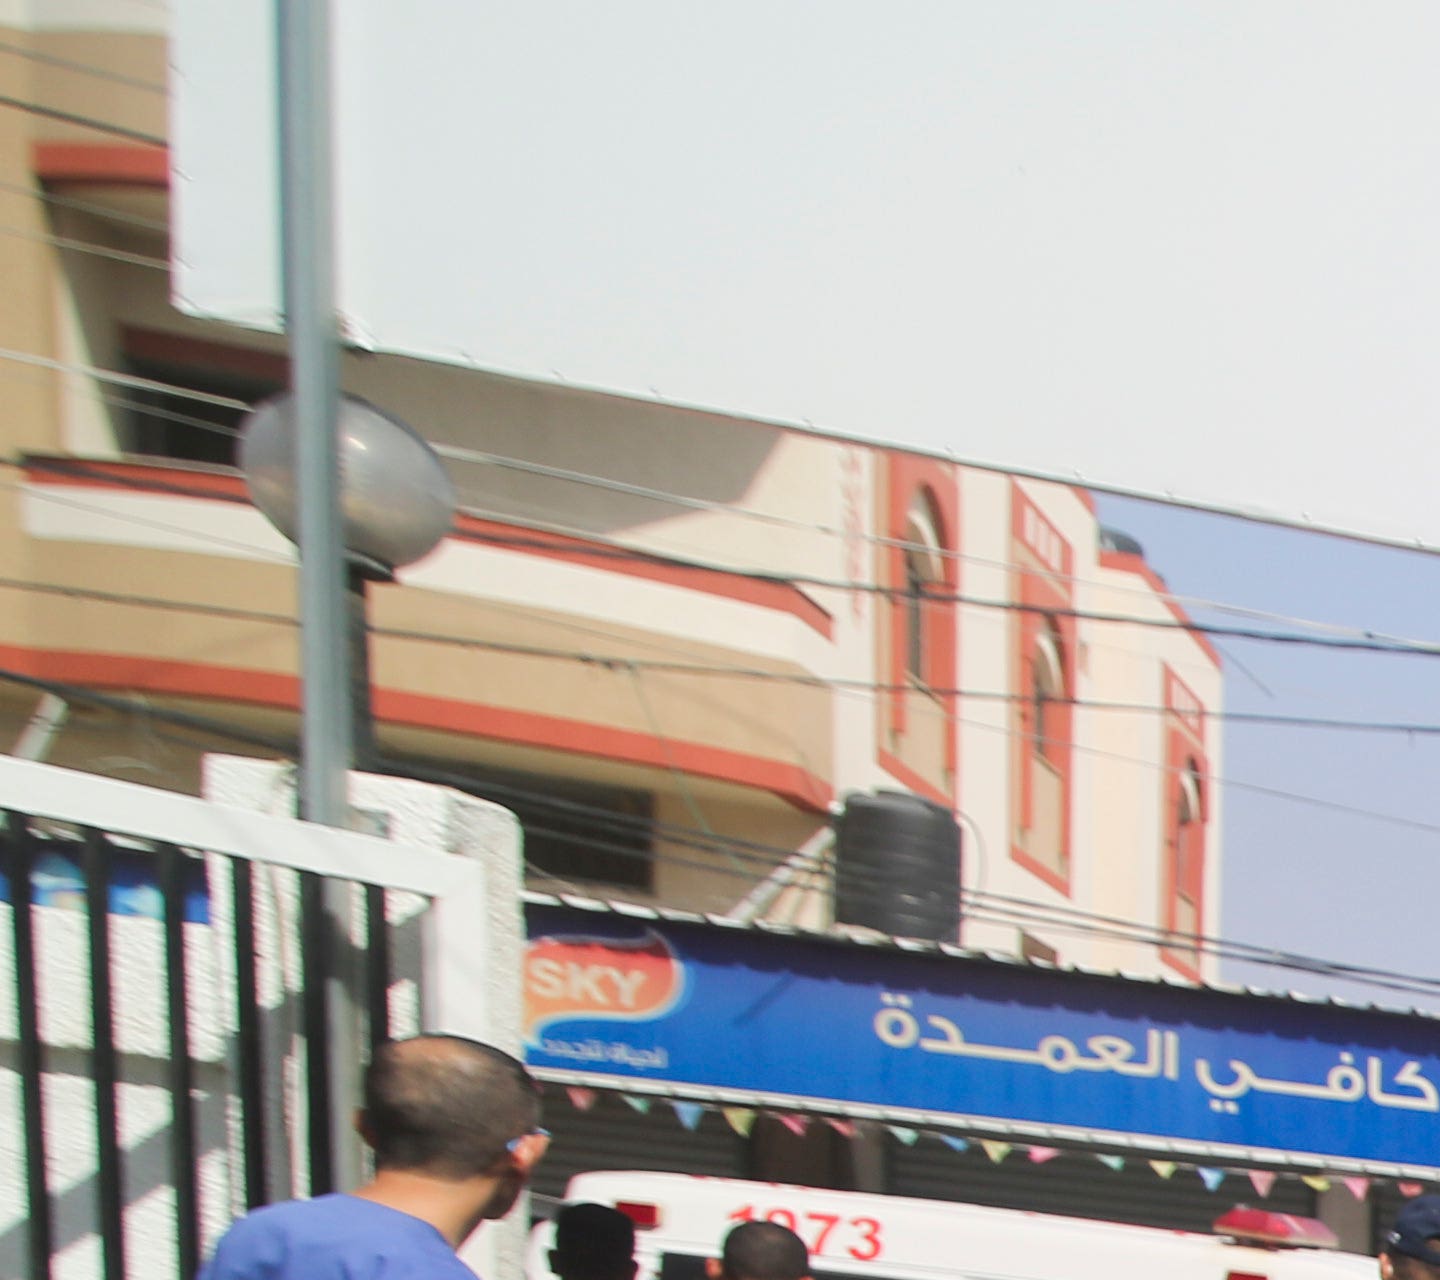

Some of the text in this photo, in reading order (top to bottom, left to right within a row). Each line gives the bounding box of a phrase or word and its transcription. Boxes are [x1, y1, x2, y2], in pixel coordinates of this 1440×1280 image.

[528, 957, 647, 1008] SKY
[872, 992, 1440, 1115] كافي العمدة
